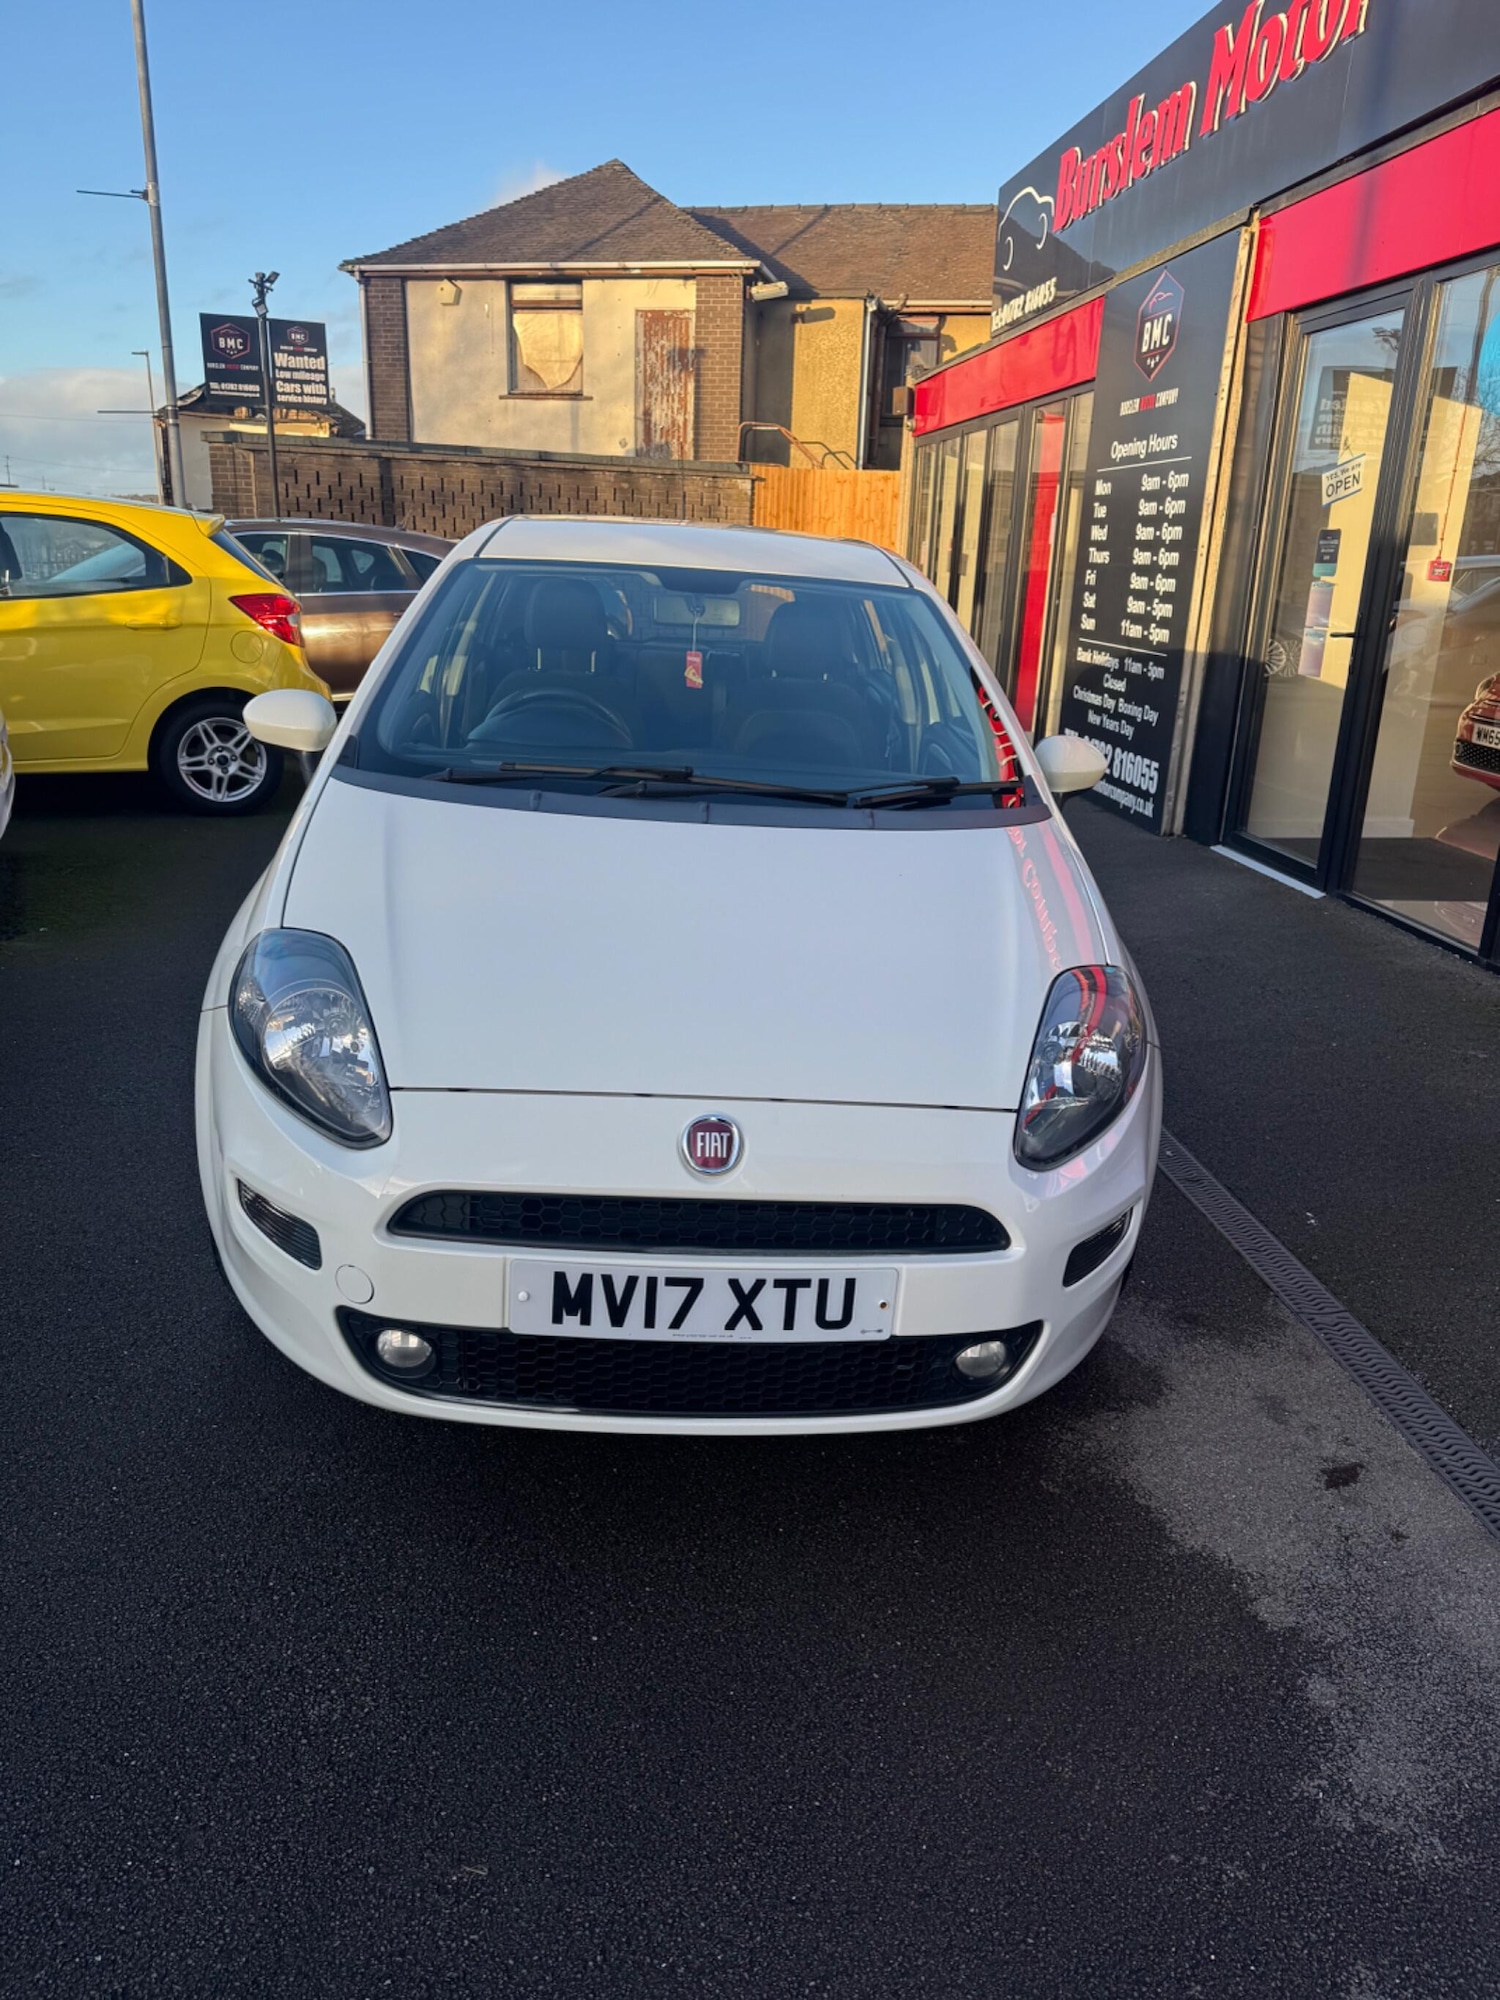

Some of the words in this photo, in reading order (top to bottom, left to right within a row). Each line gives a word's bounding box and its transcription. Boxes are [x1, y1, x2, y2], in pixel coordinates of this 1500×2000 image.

[1052, 81, 1197, 233] Burslem
[218, 337, 244, 350] BMC
[291, 332, 305, 341] BMC
[1140, 313, 1173, 353] BMC
[274, 352, 326, 370] Wanted
[275, 368, 292, 379] Low
[292, 370, 326, 382] mileage
[276, 380, 302, 394] Cars
[302, 382, 327, 395] with
[276, 394, 303, 403] service
[302, 395, 328, 405] history
[1111, 438, 1147, 462] Opening
[1148, 433, 1179, 453] Hours
[1095, 479, 1112, 495] Mon
[1141, 473, 1161, 491] 9am
[1167, 470, 1189, 492] 6pm
[1325, 470, 1361, 498] OPEN
[1093, 502, 1107, 518] Tue
[1138, 498, 1158, 516] 9am
[1164, 496, 1186, 519] 6pm
[1091, 524, 1108, 541] Wed
[1135, 522, 1155, 541] 9am
[1161, 522, 1183, 544] 6pm
[1089, 547, 1110, 564] Thurs
[1132, 547, 1152, 565] 9am
[1157, 547, 1180, 570] 6pm
[1085, 569, 1097, 585] Fri
[1129, 572, 1149, 590] 9am
[1154, 573, 1176, 596] 6pm
[1083, 591, 1096, 608] Sat
[1127, 595, 1146, 614] 9am
[1152, 598, 1173, 621] 5pm
[1081, 613, 1096, 631] Sun
[1121, 619, 1143, 639] 11am
[1149, 623, 1170, 645] 5pm
[1076, 646, 1092, 664] Bank
[1092, 650, 1120, 672] Holidays
[1124, 657, 1142, 675] 11am
[1147, 661, 1165, 681] 5pm
[1103, 673, 1127, 692] Closed
[1073, 685, 1103, 707] Christmas
[1102, 693, 1117, 714] Day
[1118, 698, 1143, 722] Boxing
[1143, 705, 1159, 727] Day
[1088, 709, 1102, 726] New
[1102, 713, 1120, 732] Years
[1120, 720, 1135, 740] Day
[1112, 747, 1159, 794] 816055
[697, 1132, 731, 1158] FIAT
[551, 1271, 704, 1330] MV17
[723, 1278, 857, 1331] XTU
